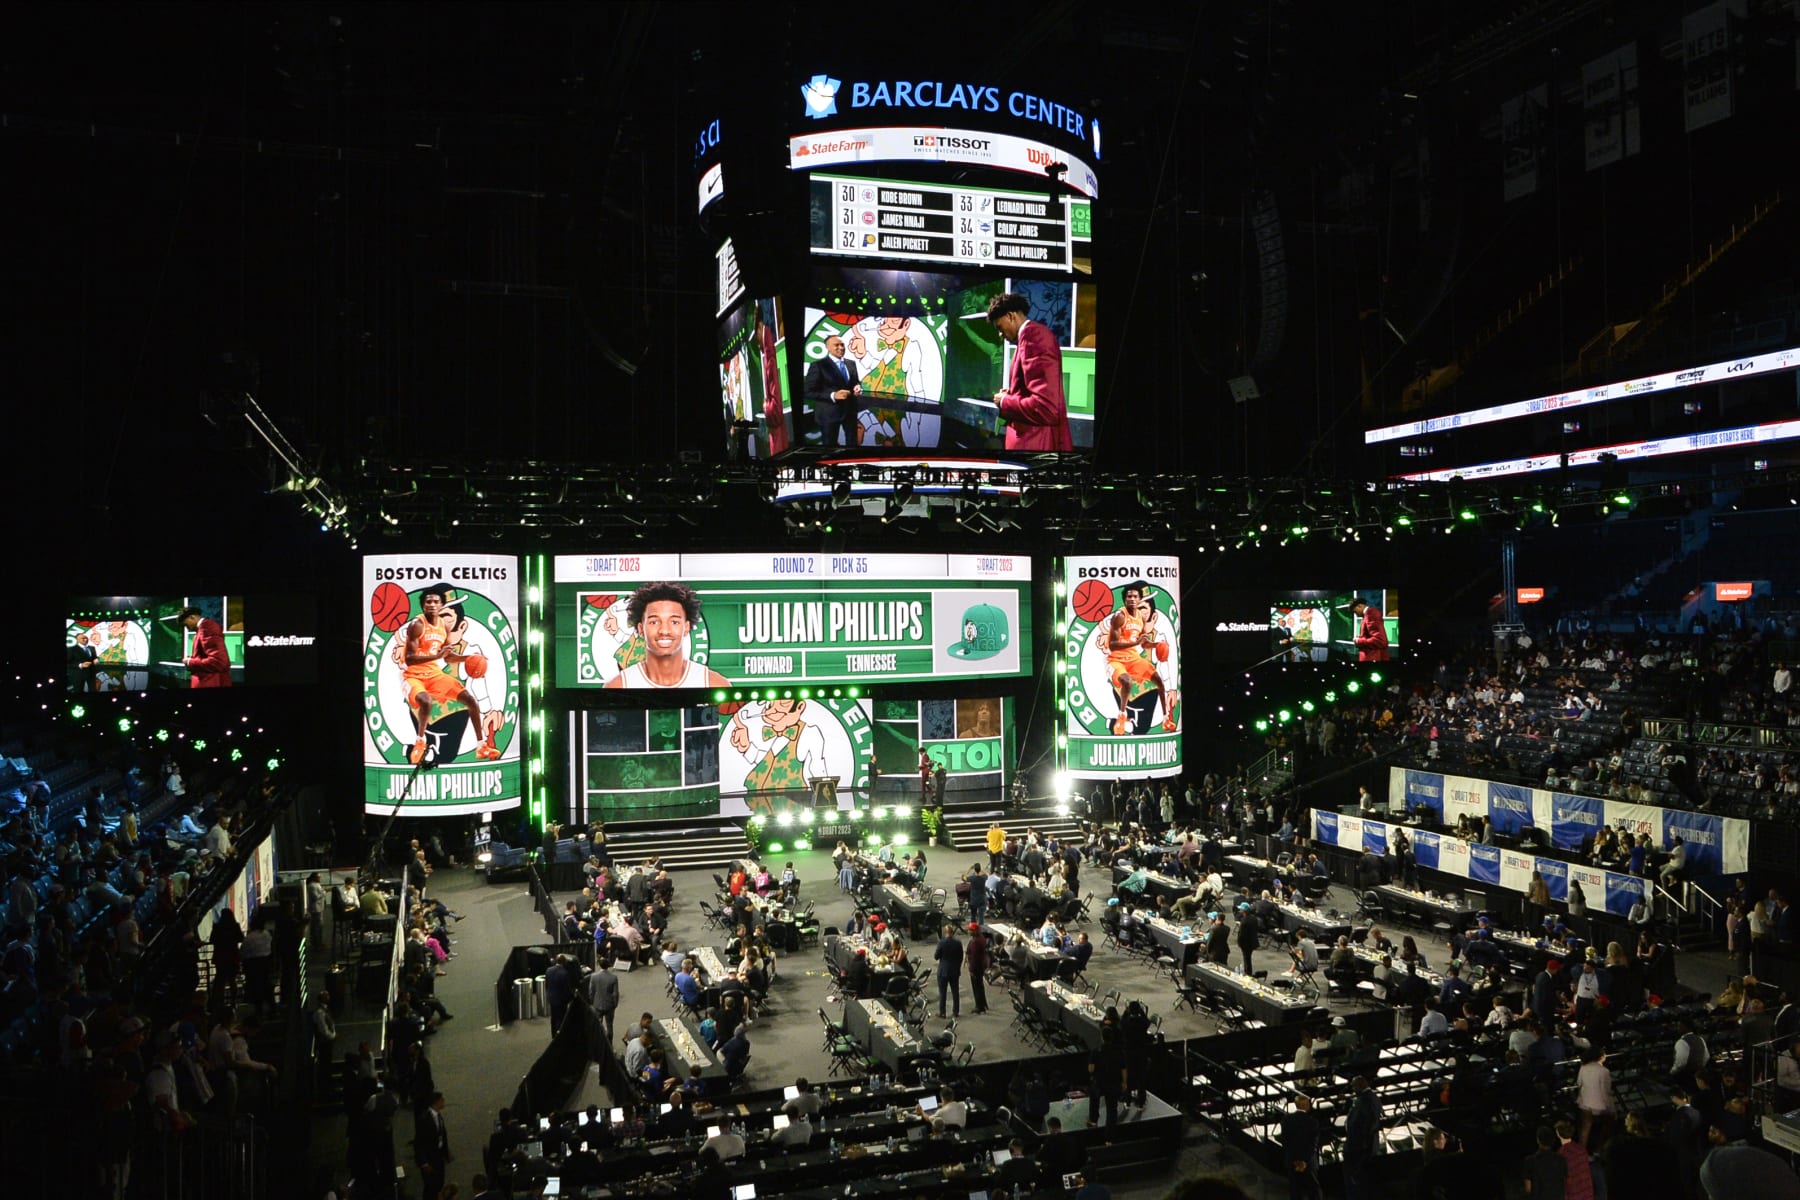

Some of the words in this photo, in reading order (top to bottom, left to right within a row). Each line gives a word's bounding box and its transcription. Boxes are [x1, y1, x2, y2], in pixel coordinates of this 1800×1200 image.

[852, 81, 999, 113] BARCLAYS
[1008, 92, 1085, 140] CENTER
[936, 136, 991, 151] TISSOT
[842, 186, 855, 202] 30
[881, 190, 899, 204] KOBE
[899, 192, 922, 206] BROWN
[960, 196, 972, 212] 33
[997, 200, 1025, 215] LEONARD
[1025, 202, 1046, 216] MILLER
[843, 208, 854, 225] 31
[881, 213, 903, 227] JAMES
[961, 218, 973, 234] 34
[1018, 224, 1038, 238] JONES
[843, 231, 855, 248] 32
[881, 235, 901, 249] JALEN
[902, 237, 929, 251] PICKETT
[961, 240, 973, 256] 35
[998, 244, 1020, 258] JULIAN
[1021, 246, 1048, 260] PHILLIPS
[1700, 434, 1718, 445] FUTURE
[1720, 431, 1739, 443] STARTS
[1740, 429, 1755, 441] HERE
[593, 558, 617, 572] DRAFT
[619, 557, 640, 571] 2023
[773, 557, 805, 573] ROUND
[808, 557, 814, 573] 2
[832, 557, 853, 573] PICK
[856, 557, 868, 573] 35
[982, 558, 998, 571] DRAFT
[999, 558, 1013, 571] 2023
[1078, 567, 1140, 578] BOSTON
[1147, 567, 1178, 578] CELTICS
[376, 567, 442, 580] BOSTON
[451, 567, 507, 580] CELTICS
[739, 602, 823, 644] JULIAN
[829, 601, 923, 642] PHILLIPS
[744, 655, 793, 674] FORWARD
[846, 653, 897, 672] TENNESSEE
[364, 632, 395, 752] BOSTON
[488, 611, 520, 726] CELTICS
[1068, 622, 1098, 726] BOSTON
[1090, 743, 1136, 766] JULIAN
[1138, 740, 1178, 765] PHILLIPS
[387, 773, 437, 800] JULIAN
[441, 770, 503, 800] PHILLIPS
